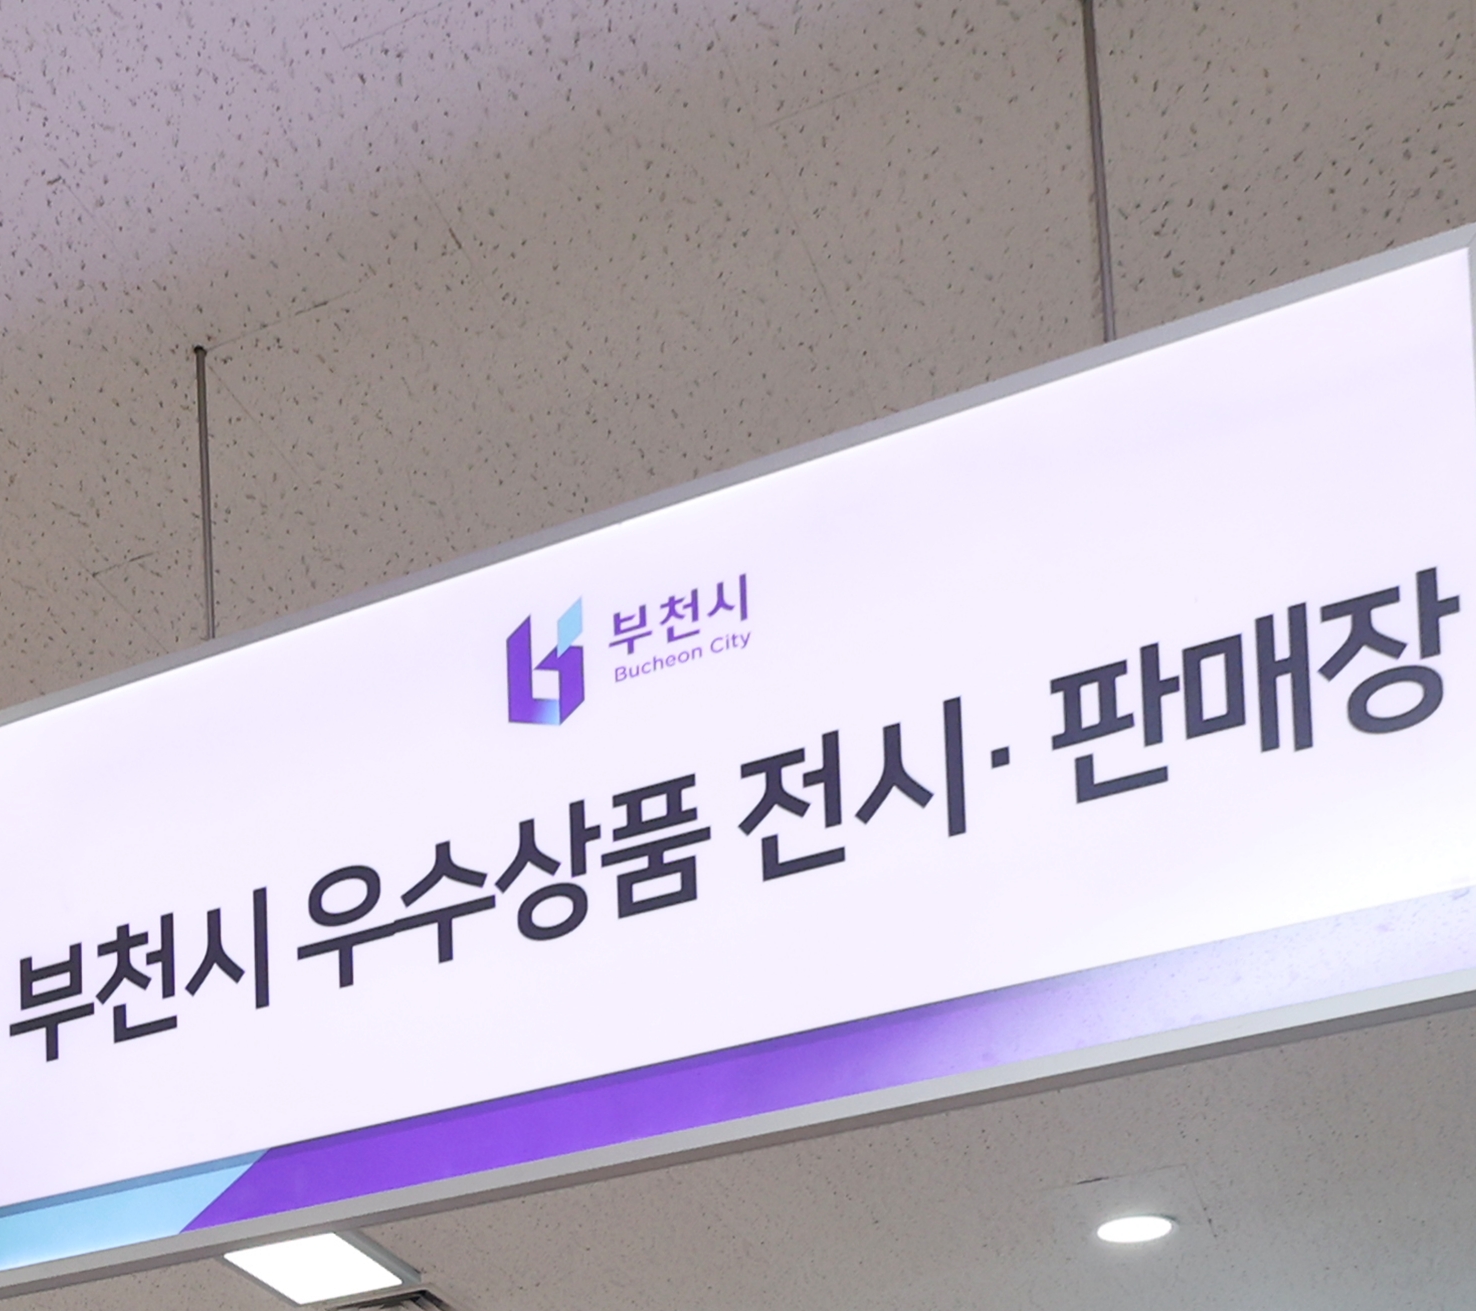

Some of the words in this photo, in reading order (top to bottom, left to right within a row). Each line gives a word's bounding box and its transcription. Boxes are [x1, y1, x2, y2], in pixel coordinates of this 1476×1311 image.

[607, 572, 752, 658] 부천시
[613, 648, 689, 684] Bucheon
[695, 629, 752, 665] City
[8, 888, 273, 1062] 부천시
[296, 772, 712, 987] 우수상품
[1051, 568, 1461, 804] 판매장
